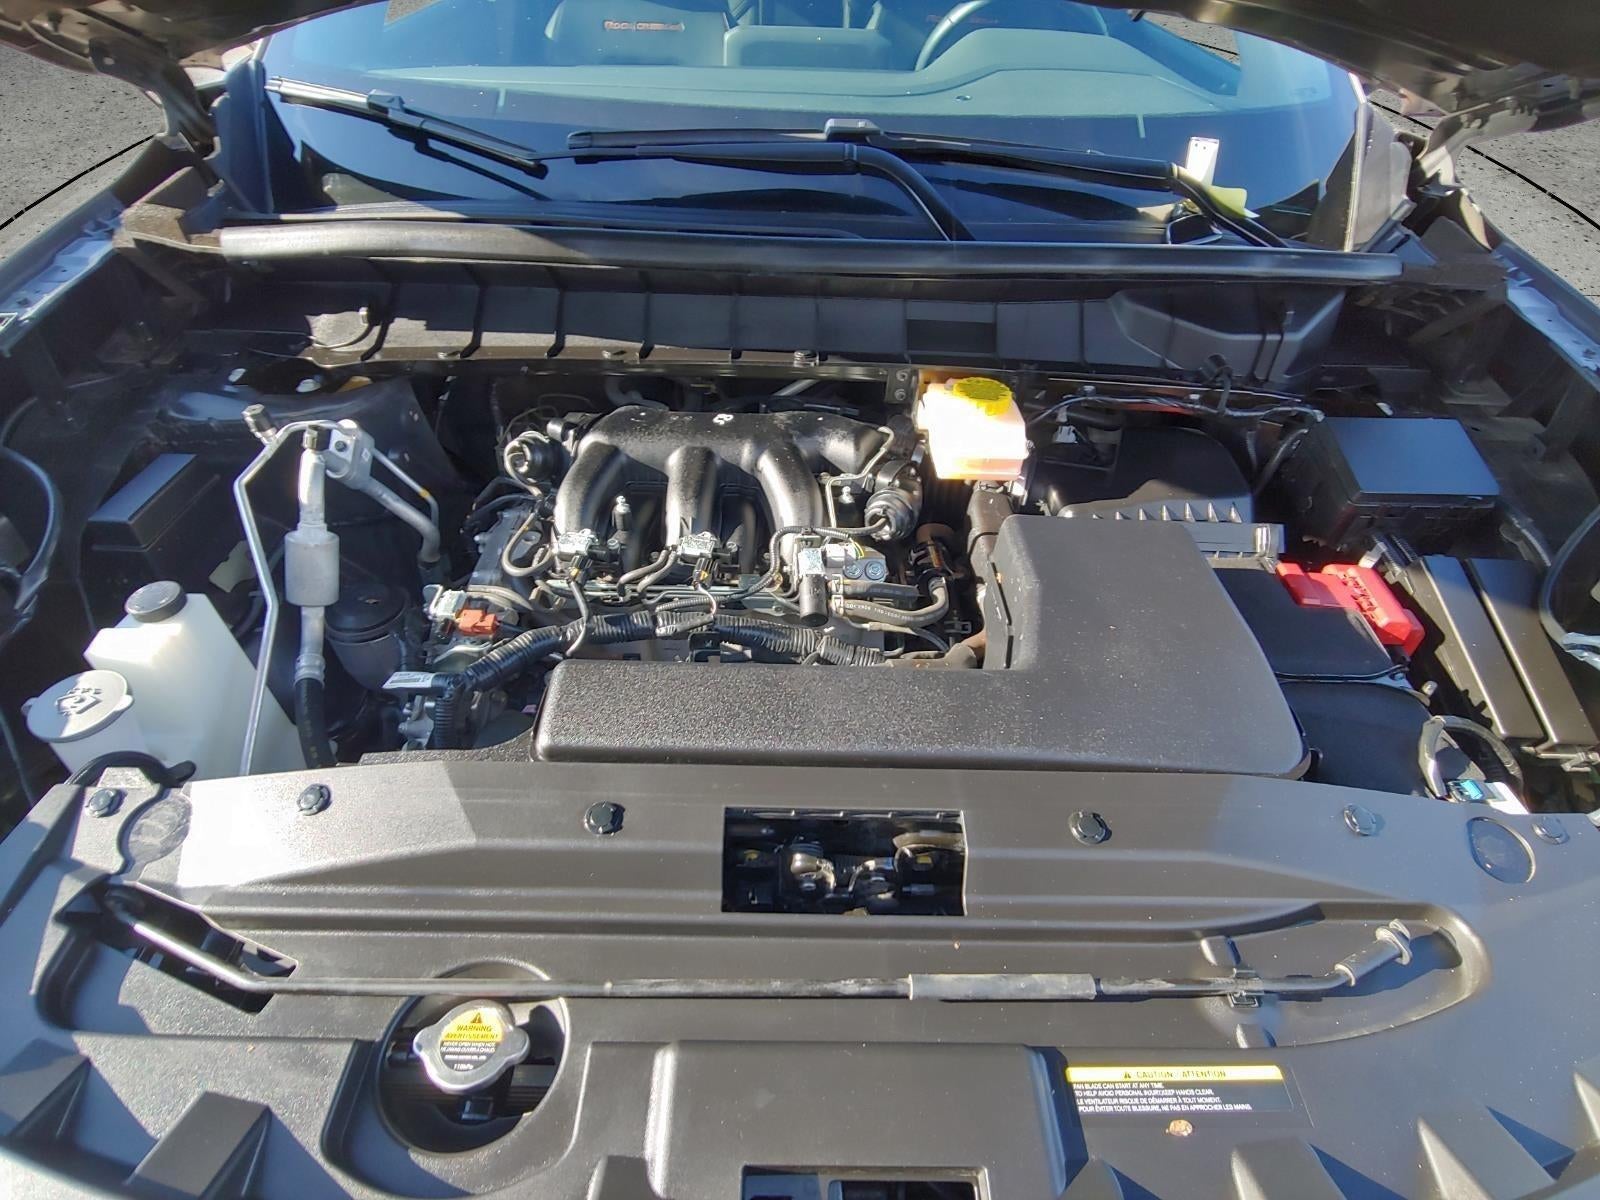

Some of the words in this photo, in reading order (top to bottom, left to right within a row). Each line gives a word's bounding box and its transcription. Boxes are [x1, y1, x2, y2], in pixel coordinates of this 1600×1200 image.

[457, 1024, 493, 1032] WARNING
[1136, 1071, 1173, 1079] CAUTION
[1182, 1070, 1226, 1078] ATTENTION
